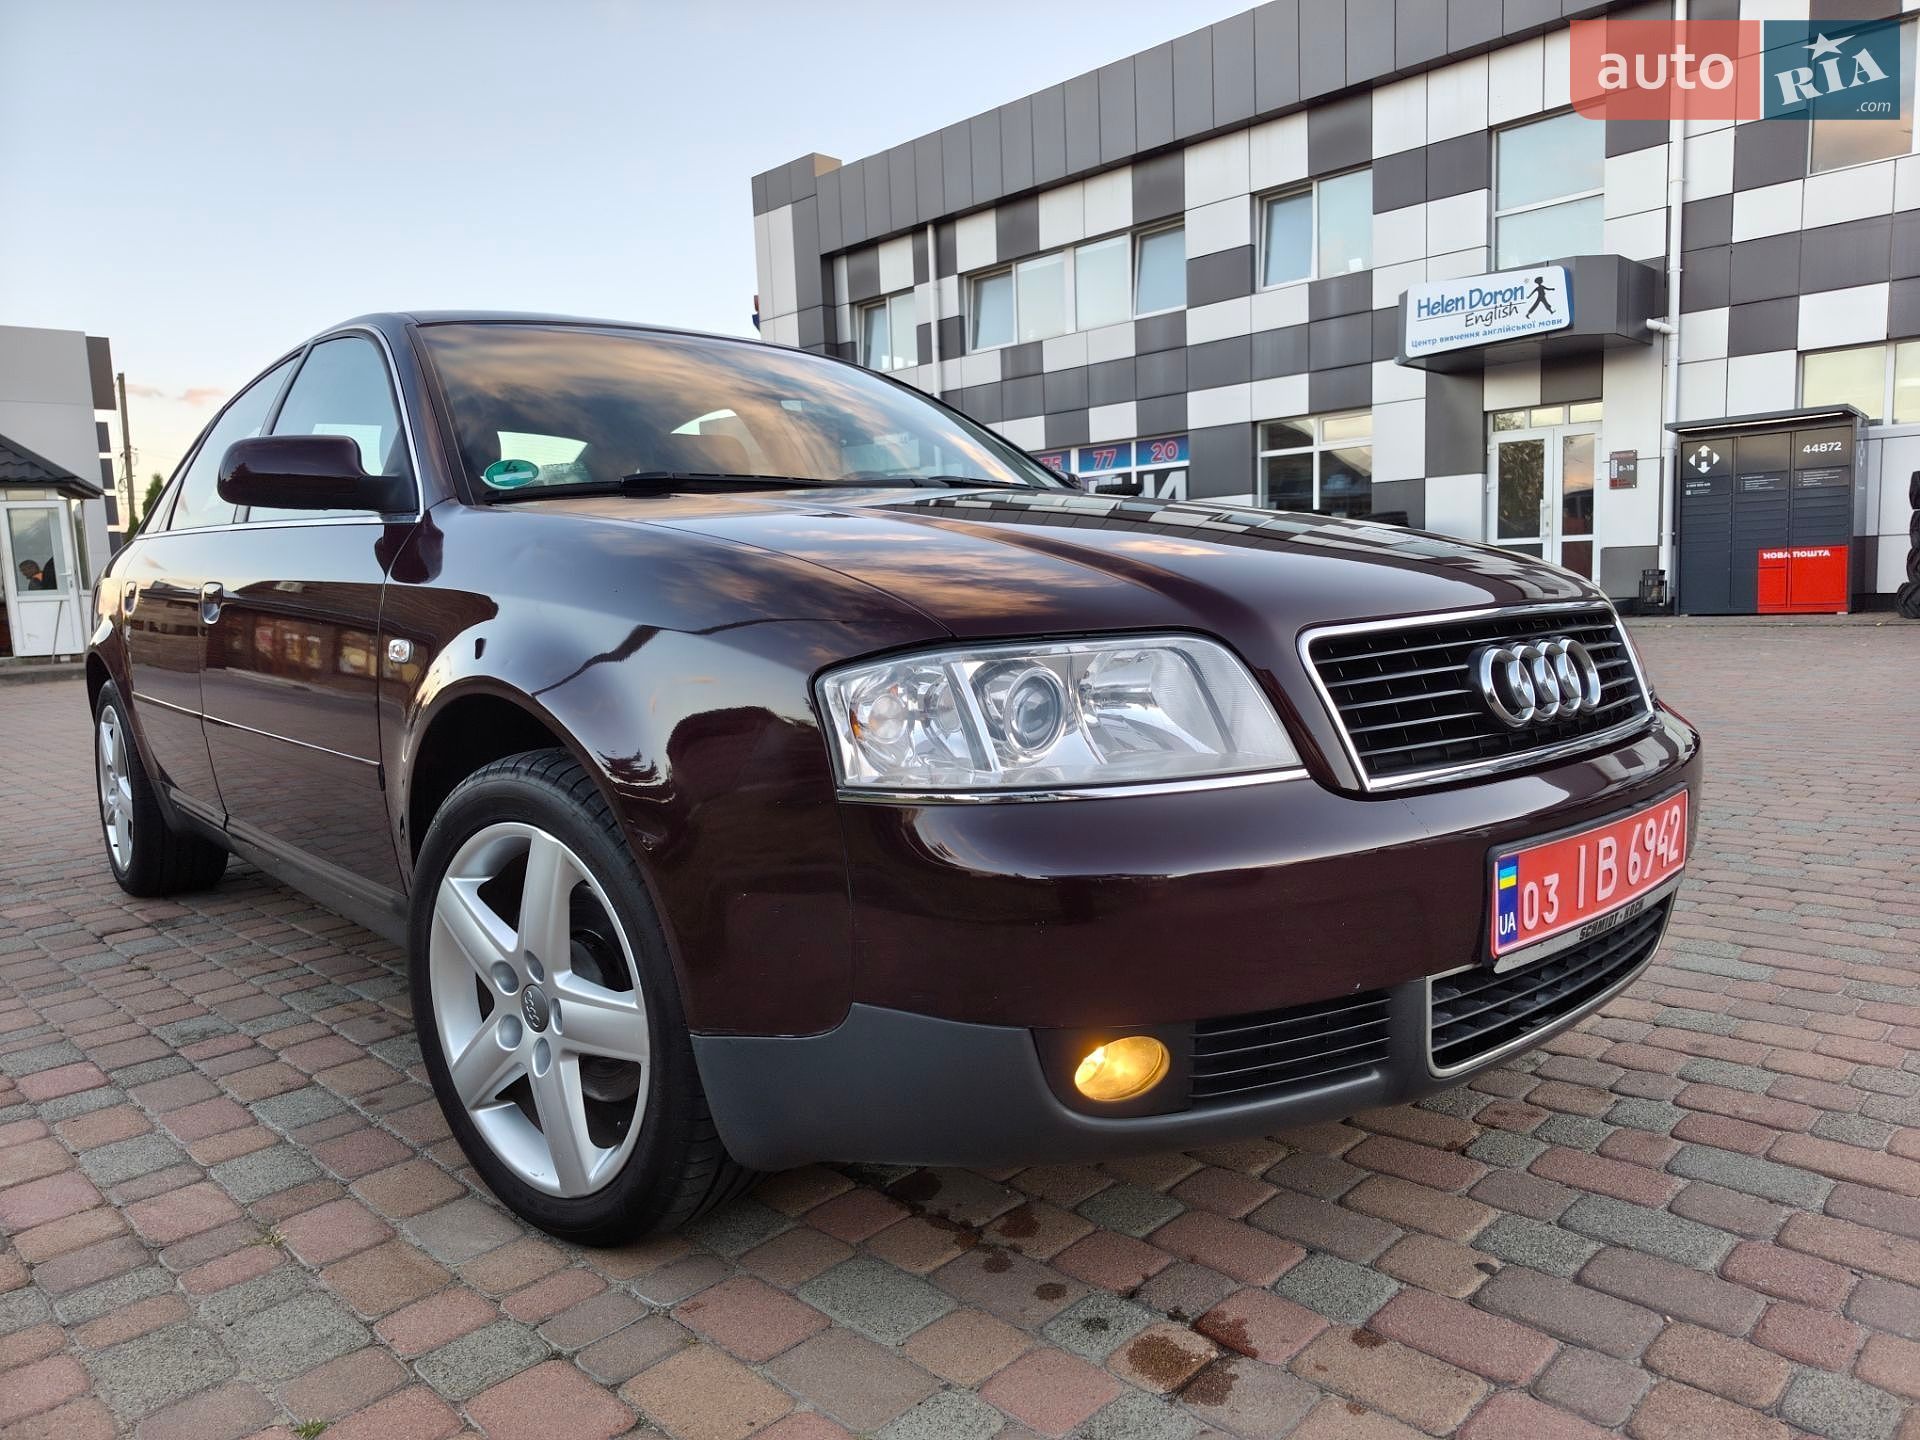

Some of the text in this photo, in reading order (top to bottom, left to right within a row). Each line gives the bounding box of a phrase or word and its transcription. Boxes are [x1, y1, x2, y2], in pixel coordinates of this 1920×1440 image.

[1417, 285, 1525, 318] Helen Doron
[1464, 302, 1519, 328] English
[1411, 318, 1563, 348] Центр вивчення англійської мови
[1151, 440, 1178, 462] 20
[1802, 441, 1842, 453] 44872
[1093, 449, 1117, 470] 77
[1763, 549, 1831, 559] НОВА ПОШТА
[1523, 873, 1559, 931] 03
[1627, 804, 1681, 886] 6942
[1499, 911, 1516, 935] UA
